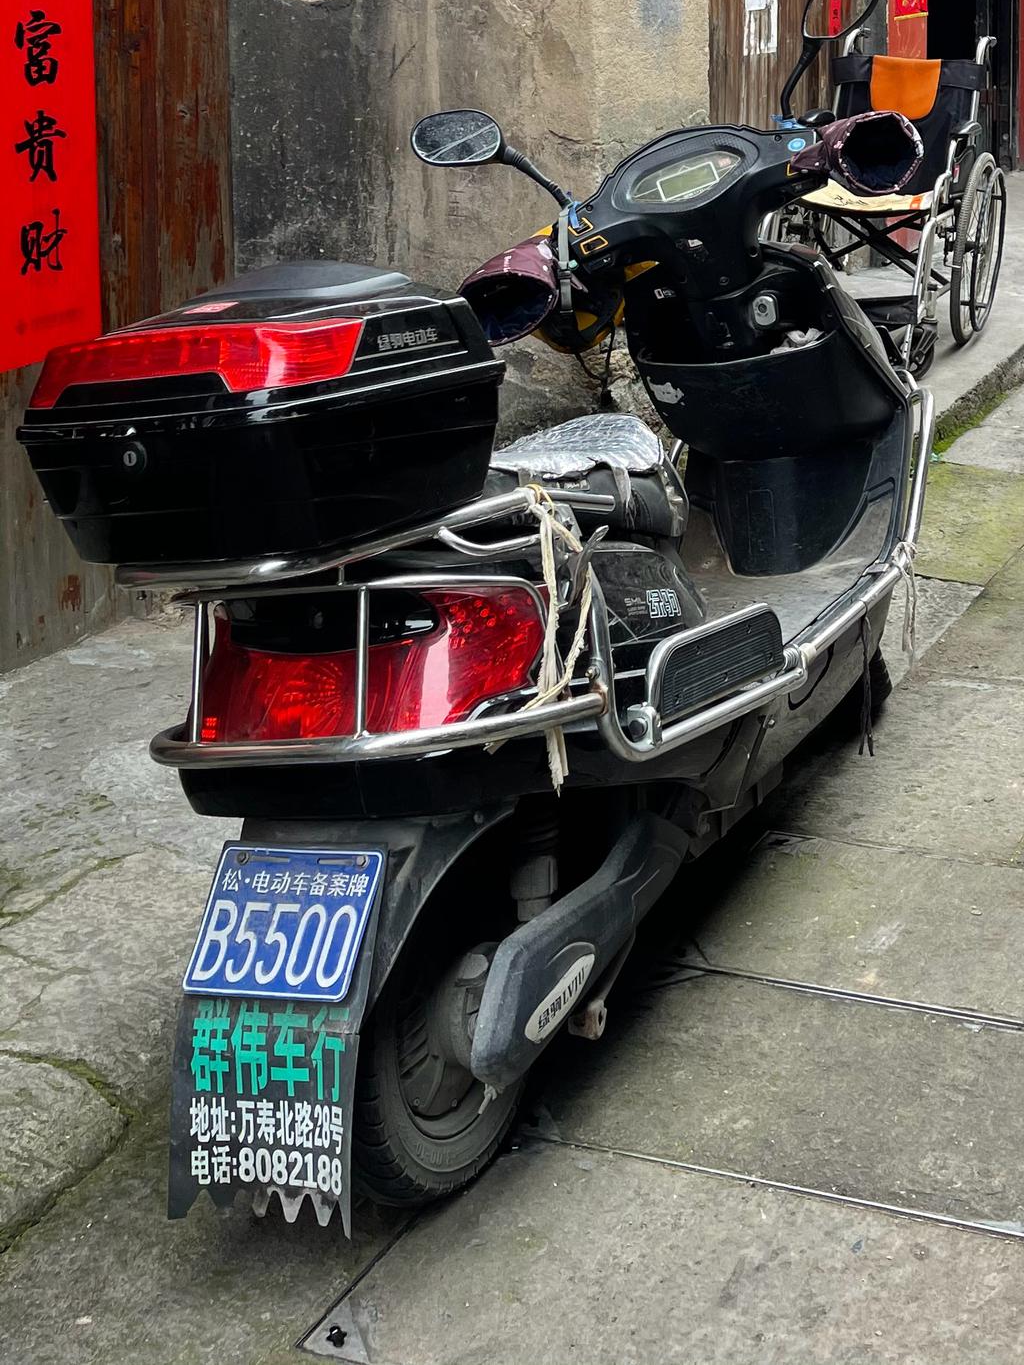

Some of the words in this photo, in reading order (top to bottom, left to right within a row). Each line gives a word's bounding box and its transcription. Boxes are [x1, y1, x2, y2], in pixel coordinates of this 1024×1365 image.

[222, 868, 370, 897] 松·电动车备案牌
[191, 899, 358, 988] B5500
[190, 999, 350, 1103] 群伟车行
[190, 1145, 342, 1196] 电话:8082188
